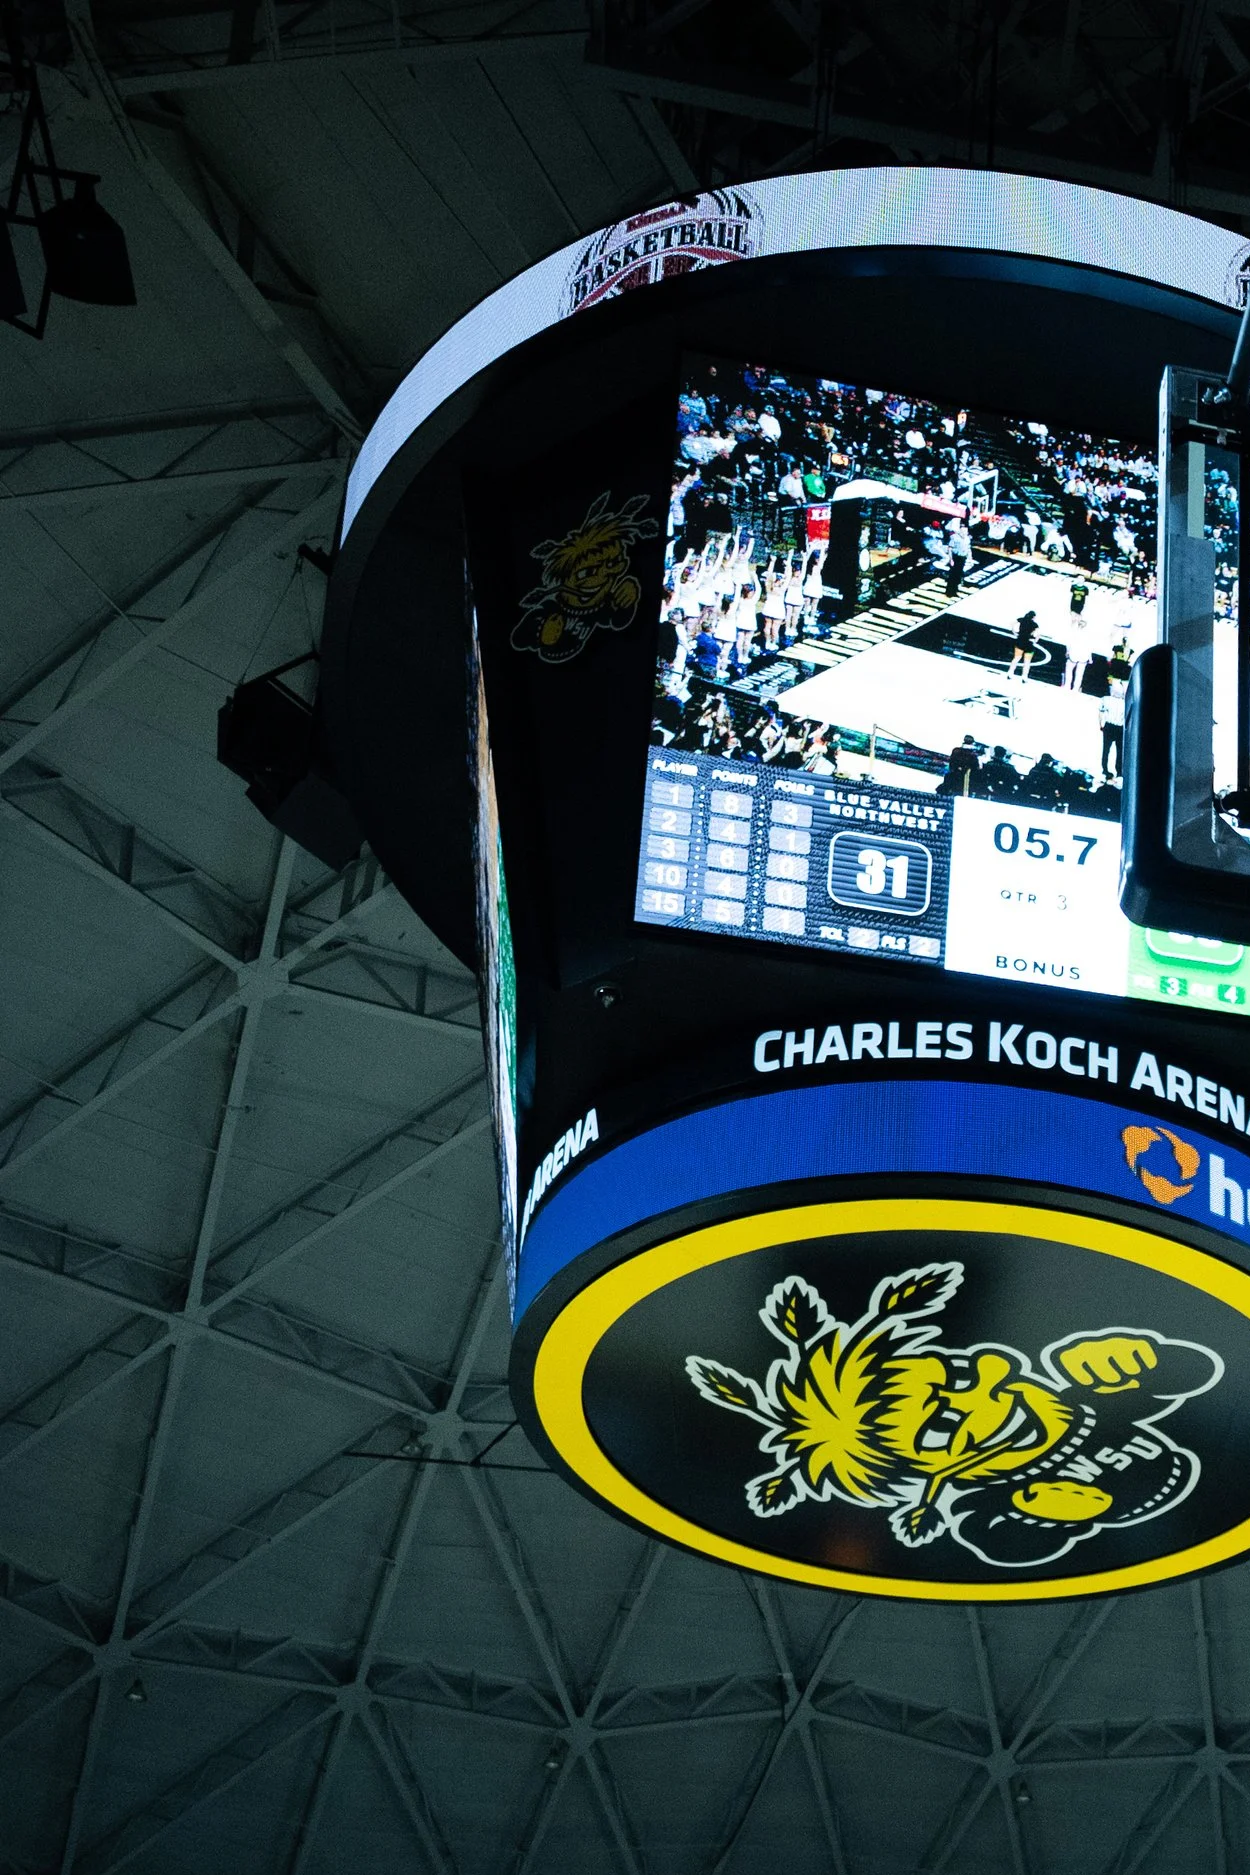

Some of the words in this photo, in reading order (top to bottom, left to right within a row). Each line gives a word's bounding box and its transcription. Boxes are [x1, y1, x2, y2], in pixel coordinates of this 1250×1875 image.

[670, 786, 680, 805] 1
[784, 806, 798, 824] 3
[824, 789, 871, 808] BLUE
[879, 799, 946, 820] VALLEY
[829, 804, 940, 831] NORTHWEST
[662, 813, 676, 832] 2
[722, 822, 736, 841] 4
[787, 831, 797, 850] 1
[994, 822, 1098, 866] 05.7
[661, 840, 675, 859] 3
[653, 868, 681, 887] 10
[855, 849, 909, 899] 31
[652, 895, 679, 914] 15
[1000, 889, 1037, 904] QTR
[995, 955, 1080, 980] BONUS
[1167, 977, 1180, 996] 3
[1223, 985, 1238, 1004] 4
[753, 1021, 973, 1074] CHARLES
[989, 1023, 1119, 1083] KOCH
[1056, 1436, 1162, 1483] WSU
